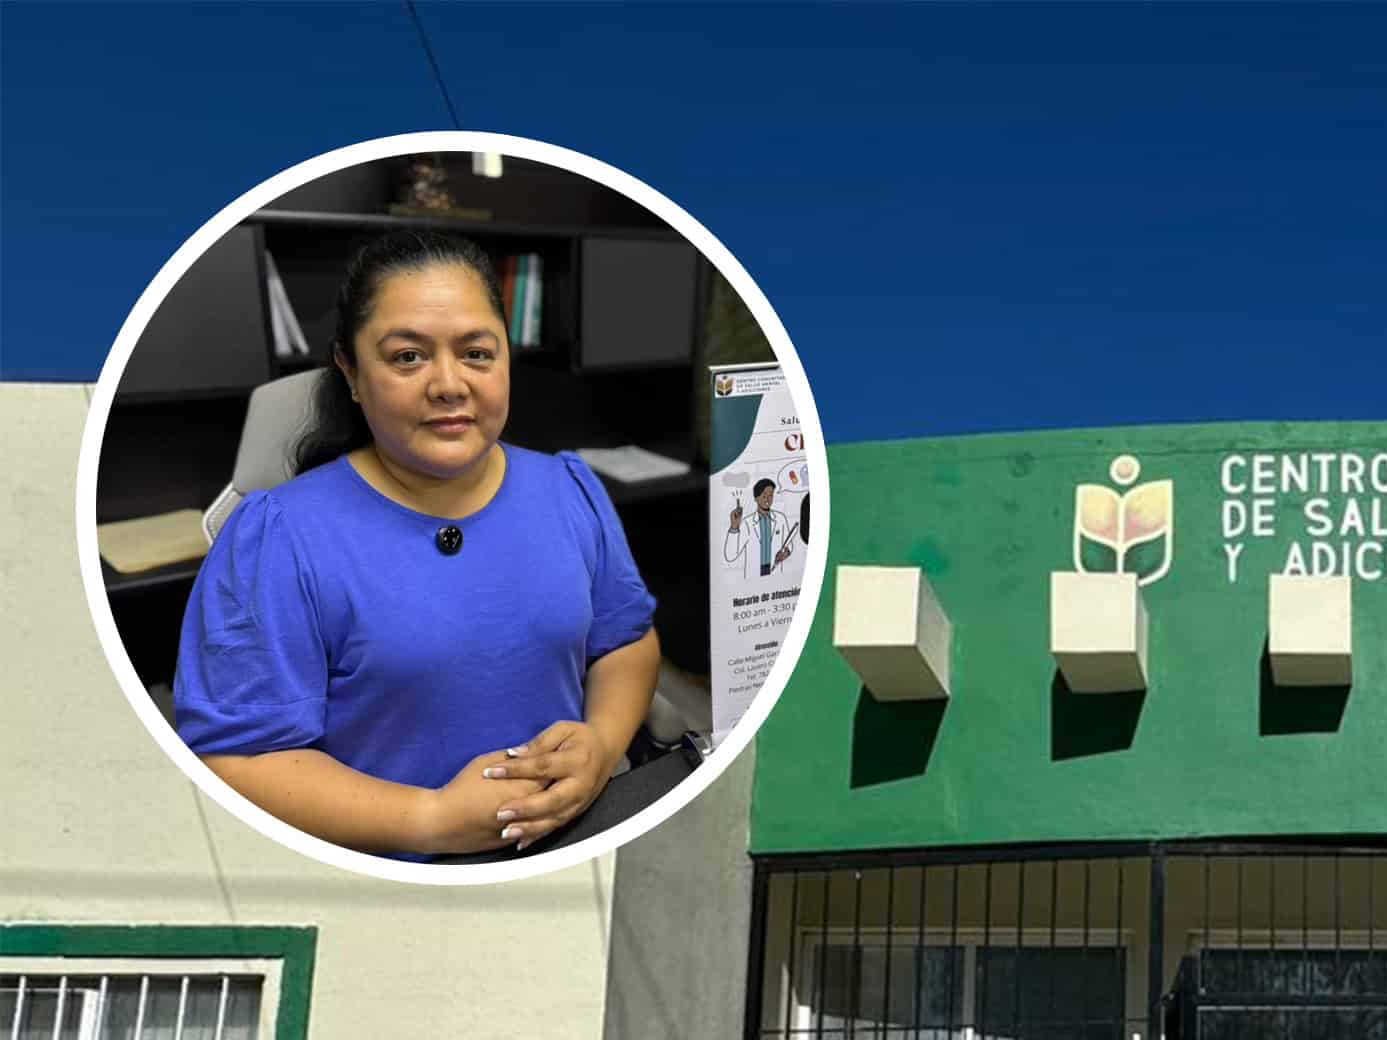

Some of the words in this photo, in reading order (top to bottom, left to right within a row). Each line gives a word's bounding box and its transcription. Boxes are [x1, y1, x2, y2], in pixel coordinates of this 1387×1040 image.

[1221, 499, 1275, 538] DE
[1224, 545, 1243, 583] Y
[761, 593, 769, 602] de
[753, 608, 766, 616] am
